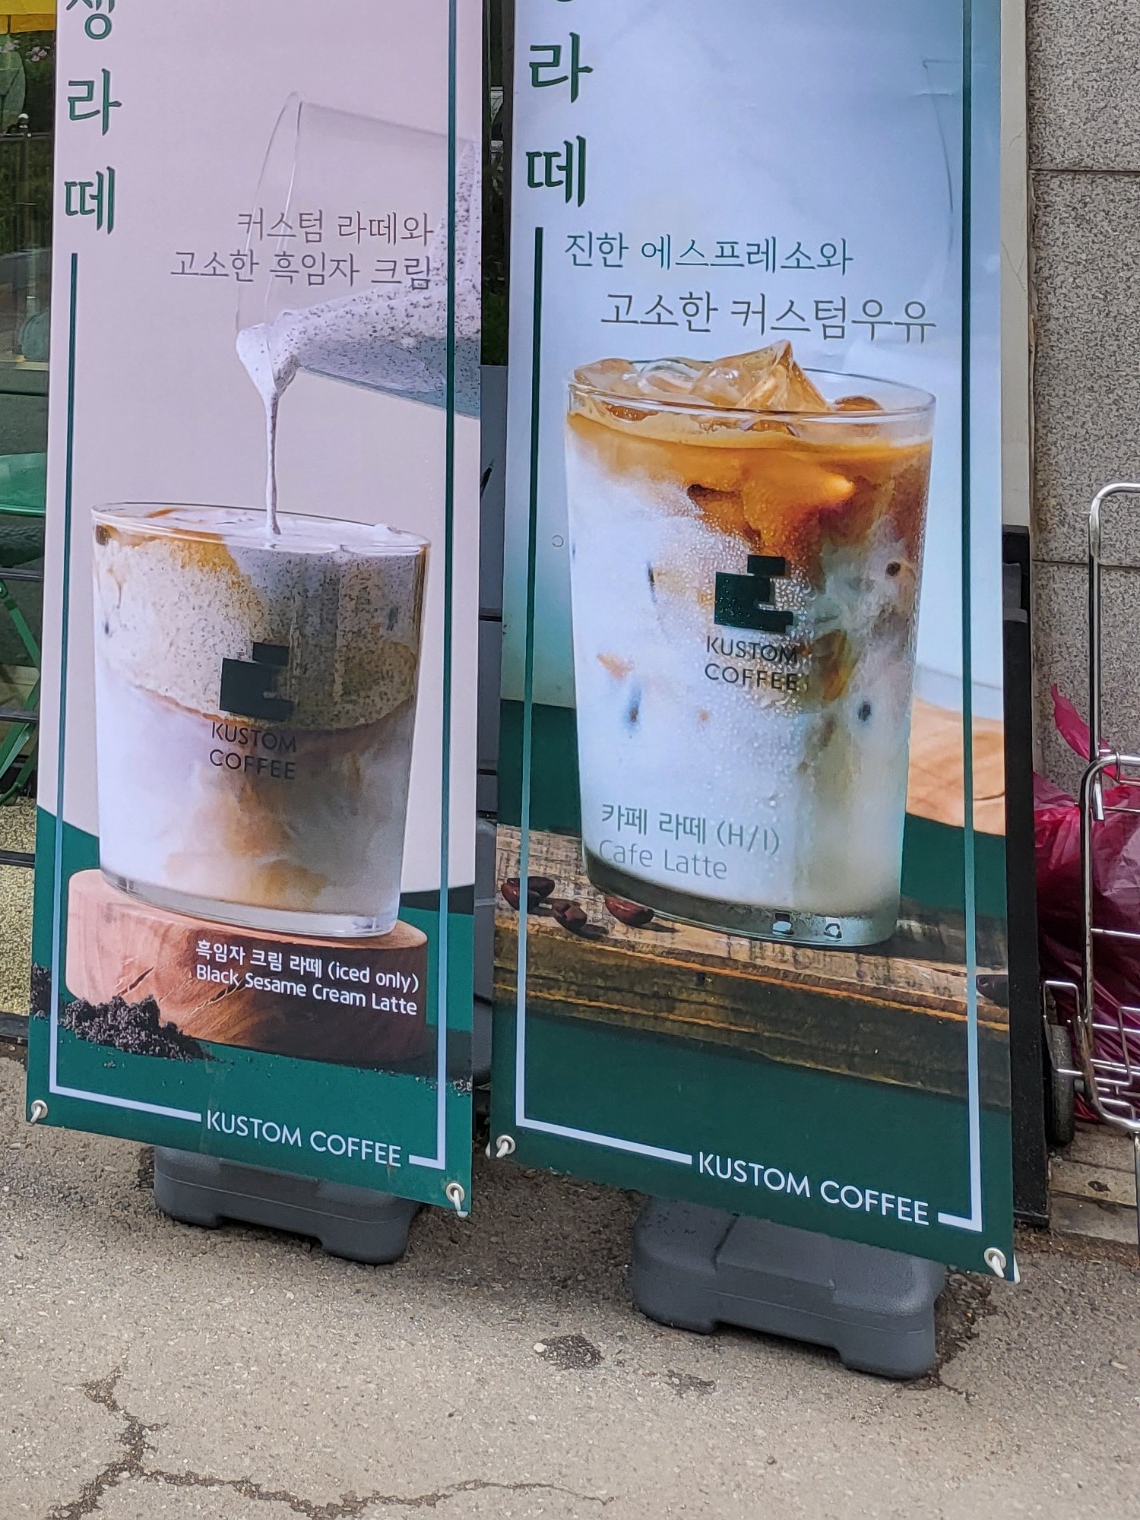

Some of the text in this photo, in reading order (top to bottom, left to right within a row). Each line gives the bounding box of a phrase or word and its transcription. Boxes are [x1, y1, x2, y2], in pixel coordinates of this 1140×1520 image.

[237, 207, 435, 247] 커스텀 라떼와
[170, 248, 260, 283] 고소한
[269, 250, 361, 287] 흑임자
[564, 230, 854, 276] 진한 에스프레소와
[600, 290, 937, 344] 고소한 커스텀우유
[706, 635, 797, 664] KUSTOM
[704, 663, 798, 691] COFFEE
[212, 721, 297, 753] KUSTOM
[209, 748, 296, 780] COFFEE
[602, 803, 648, 836] 카페
[659, 812, 706, 845] 라떼
[598, 838, 727, 880] Cafe Latte
[196, 939, 419, 994] 흑임자 크림 라떼 (iced only)
[196, 963, 418, 1016] Black Sesame Cream Latte
[207, 1109, 401, 1168] KUSTOM COFFEE
[698, 1151, 930, 1226] KUSTOM COFFEE
